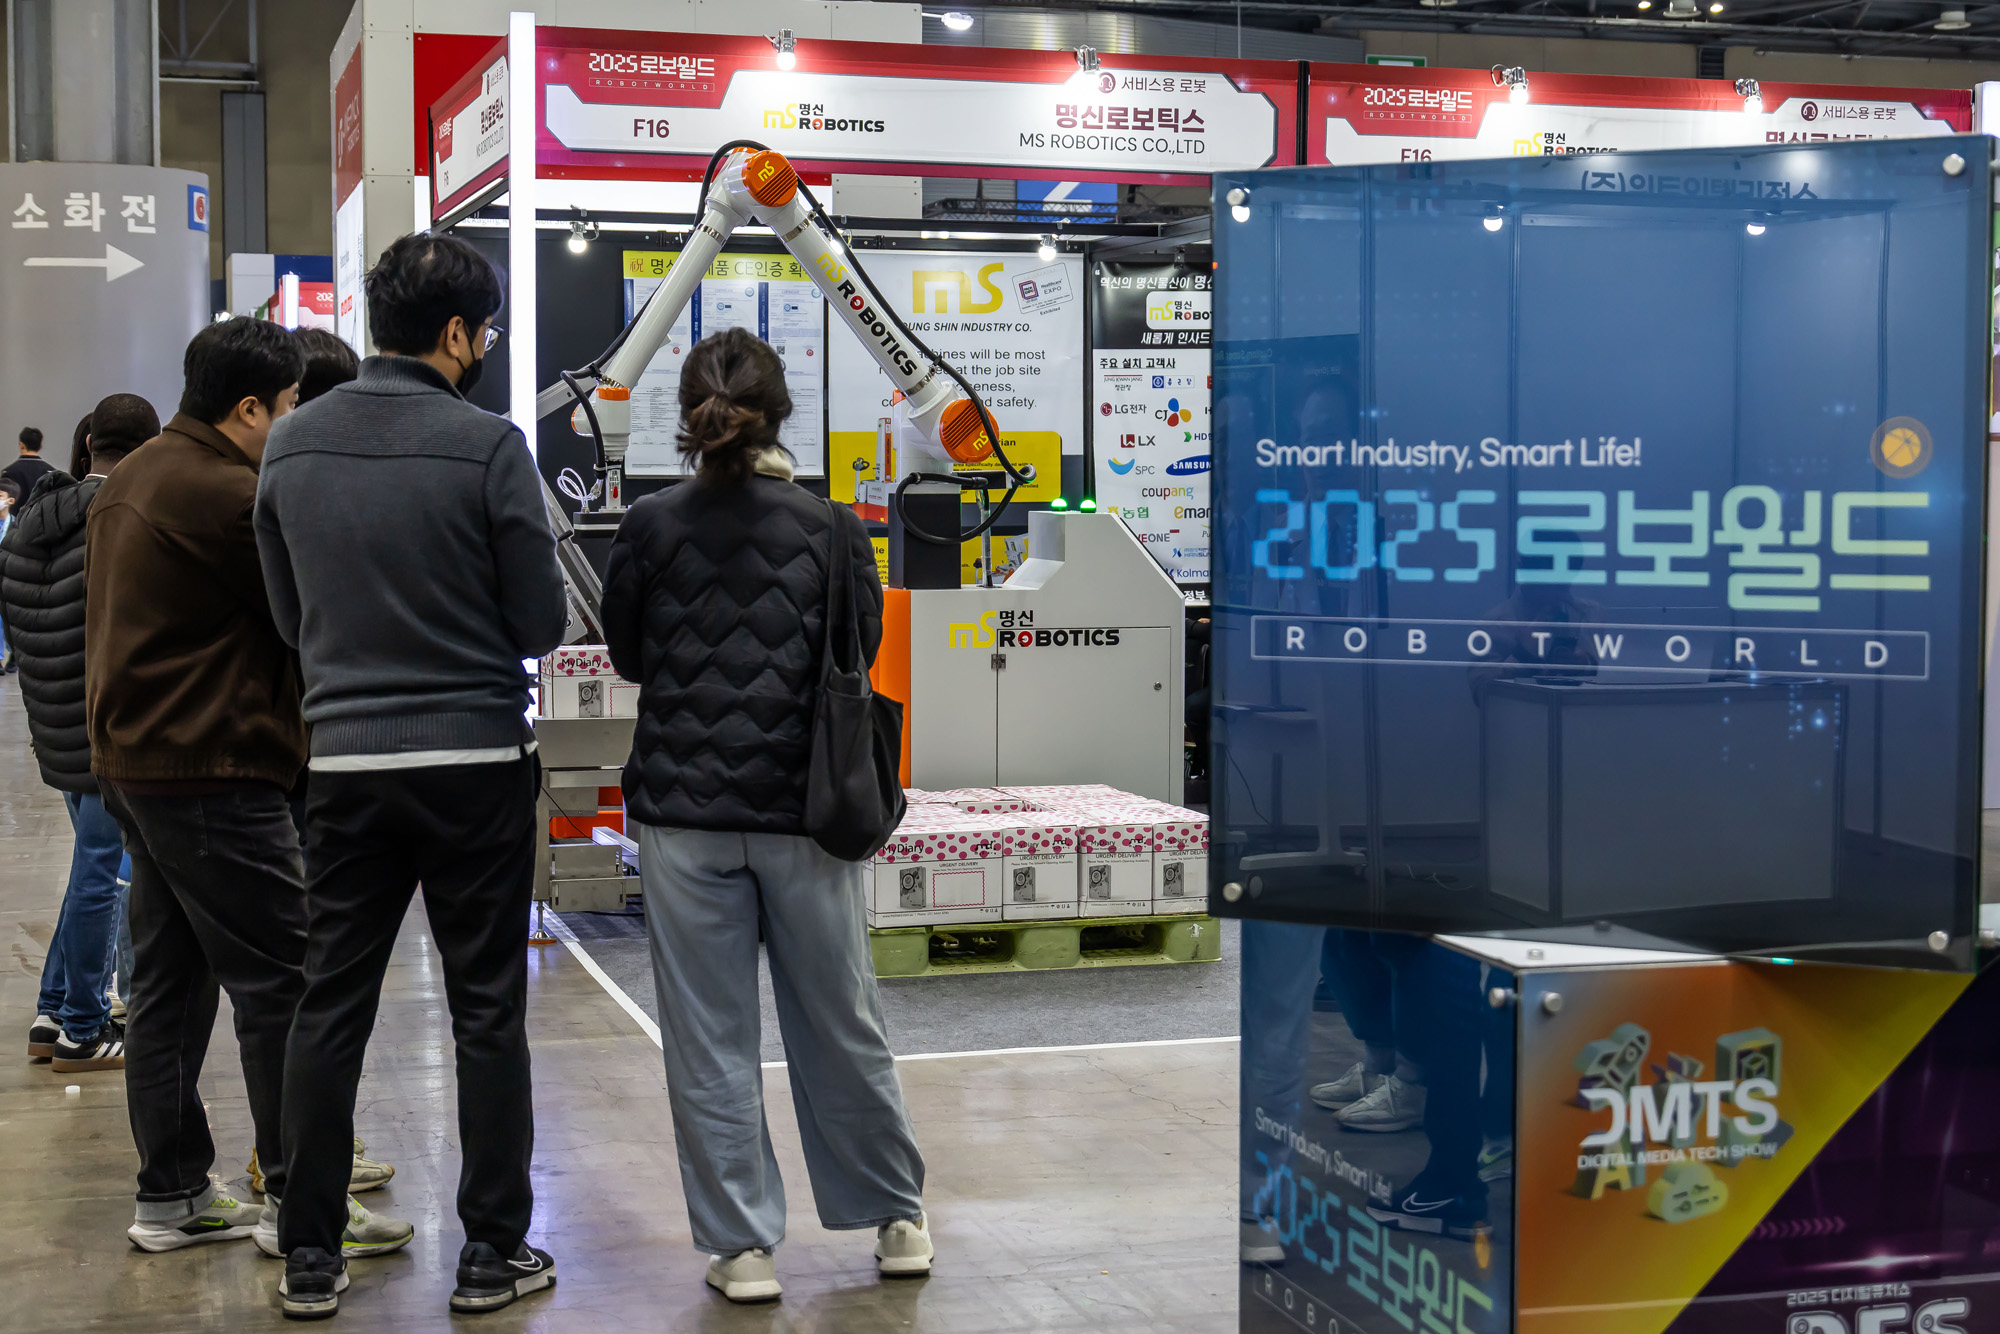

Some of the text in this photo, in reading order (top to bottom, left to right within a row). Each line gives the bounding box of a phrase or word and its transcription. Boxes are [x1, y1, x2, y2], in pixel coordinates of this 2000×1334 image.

[1121, 76, 1207, 94] 서비스용 로봇
[799, 103, 824, 117] 명신
[1822, 105, 1897, 120] 서비스용 로봇
[799, 117, 885, 133] ROBOTICS
[1055, 104, 1205, 134] 명신로보틱스
[632, 118, 670, 139] F16
[1019, 133, 1205, 155] MS ROBOTICS CO.,LTD
[1543, 133, 1566, 144] 명신
[1401, 148, 1432, 163] F16
[11, 191, 156, 234] 소화전
[734, 261, 784, 278] CE인증
[1100, 276, 1132, 289] 혁신의
[1044, 286, 1062, 295] EXPO
[1174, 301, 1192, 310] 명신
[1174, 311, 1212, 320] ROBO
[837, 279, 918, 376] ROBOTICS
[933, 322, 960, 332] SHIN
[960, 322, 1012, 332] INDUSTRY
[1014, 323, 1032, 332] CO.
[1140, 332, 1174, 345] 새롭게
[970, 349, 990, 360] will
[995, 349, 1010, 360] be
[1014, 350, 1046, 360] most
[1100, 358, 1176, 369] 주요 설치 고객사
[971, 365, 992, 375] the
[995, 365, 1015, 378] job
[1019, 365, 1041, 375] site
[996, 397, 1037, 410] safety.
[1155, 409, 1168, 421] CJ
[1138, 435, 1156, 446] LX
[1255, 436, 1641, 473] Smart Industry, Smart Life!
[1135, 465, 1155, 475] SPC
[1141, 487, 1194, 500] coupang
[1122, 506, 1149, 519] 농협
[999, 610, 1034, 628] 명신
[999, 629, 1120, 648] ROBOTICS
[561, 658, 602, 668] MyDiary
[1014, 841, 1039, 849] MyDiary
[1091, 840, 1115, 848] MyDiary
[1165, 837, 1187, 845] MyDiary
[882, 843, 924, 855] MyDiary
[1579, 1077, 1779, 1148] DMTS
[1255, 1106, 1391, 1206] Smart Industry, Smart Life!
[1577, 1142, 1778, 1169] DIGITAL MEDIA TECH SHOW
